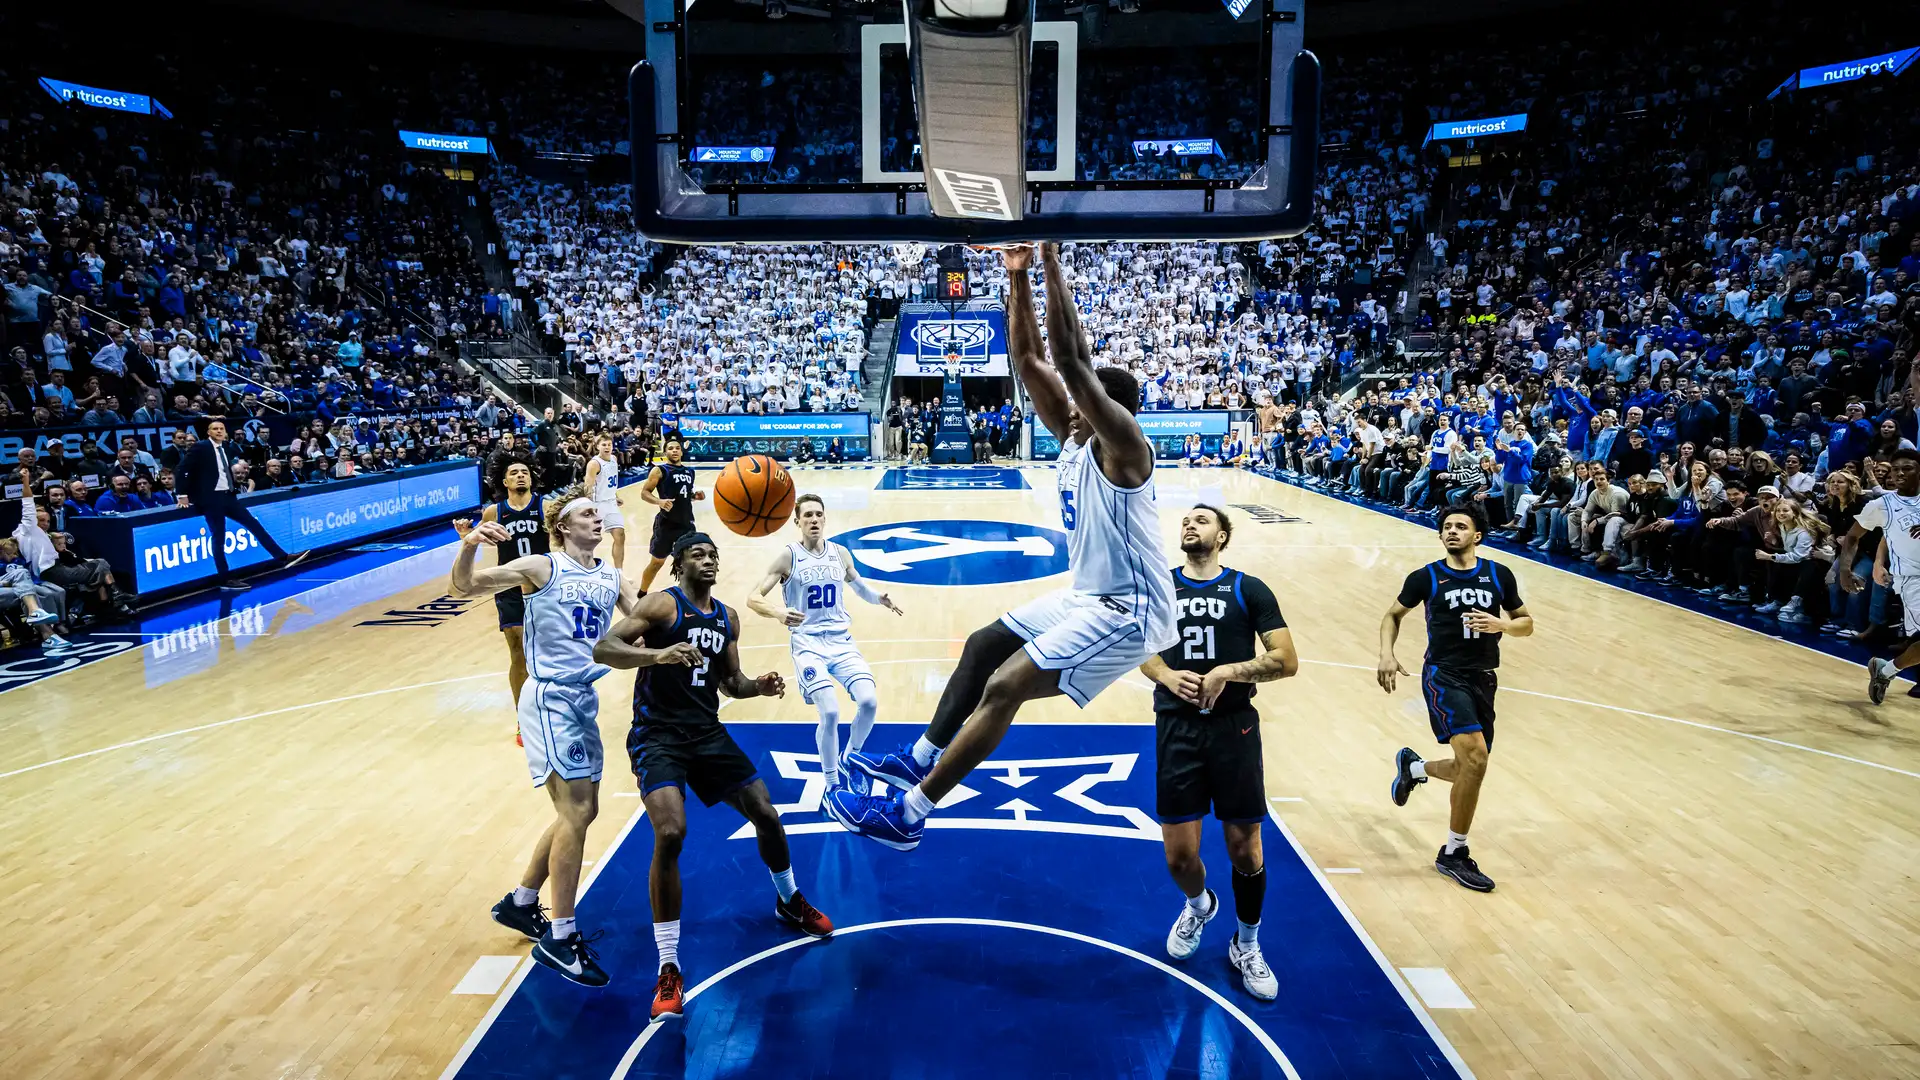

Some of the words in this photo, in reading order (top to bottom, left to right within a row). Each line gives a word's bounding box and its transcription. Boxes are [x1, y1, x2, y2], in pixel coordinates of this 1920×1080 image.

[1451, 120, 1506, 135] nutricost
[417, 137, 469, 149] nutricost
[944, 171, 1005, 215] BUILT
[947, 272, 965, 281] 3:24
[950, 282, 962, 296] 19
[673, 474, 691, 484] TCU
[680, 485, 688, 498] 4
[300, 517, 323, 536] Use
[326, 508, 357, 529] Code
[359, 495, 412, 521] "COUGAR"
[414, 494, 427, 509] for
[427, 489, 445, 505] 20%
[446, 485, 460, 501] Off
[505, 520, 538, 536] TCU
[517, 537, 531, 557] 0
[798, 565, 841, 586] BYU
[559, 581, 617, 609] BYU
[807, 584, 836, 610] 20
[1444, 588, 1493, 610] TCU
[1175, 597, 1227, 621] TCU
[572, 606, 602, 639] 15
[687, 627, 726, 654] TCU
[1183, 625, 1216, 660] 21
[691, 656, 710, 687] 2
